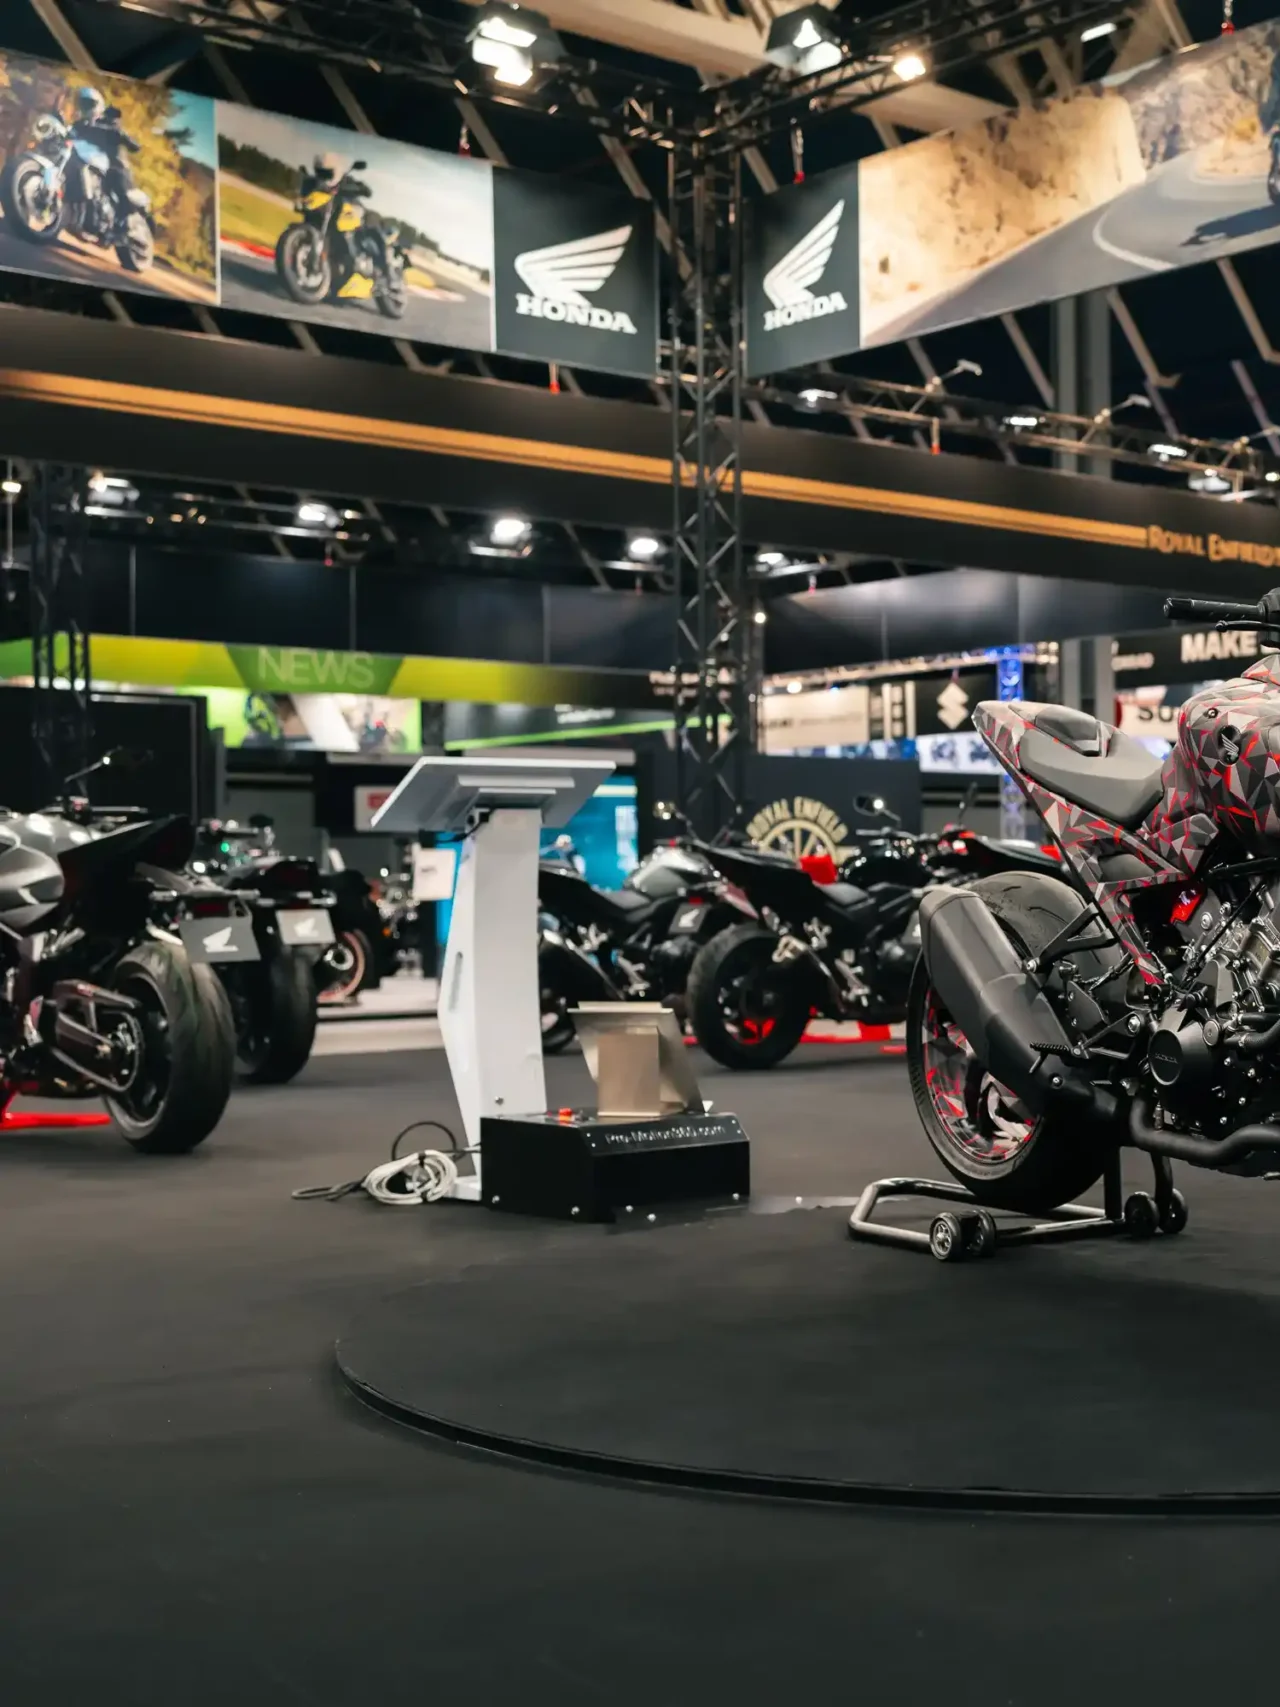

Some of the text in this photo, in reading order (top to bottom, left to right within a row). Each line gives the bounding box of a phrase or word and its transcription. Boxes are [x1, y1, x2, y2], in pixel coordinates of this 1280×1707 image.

[515, 292, 638, 335] HONDA
[763, 291, 848, 332] HONDA
[257, 646, 375, 690] NEWS
[1181, 630, 1258, 664] MAKE
